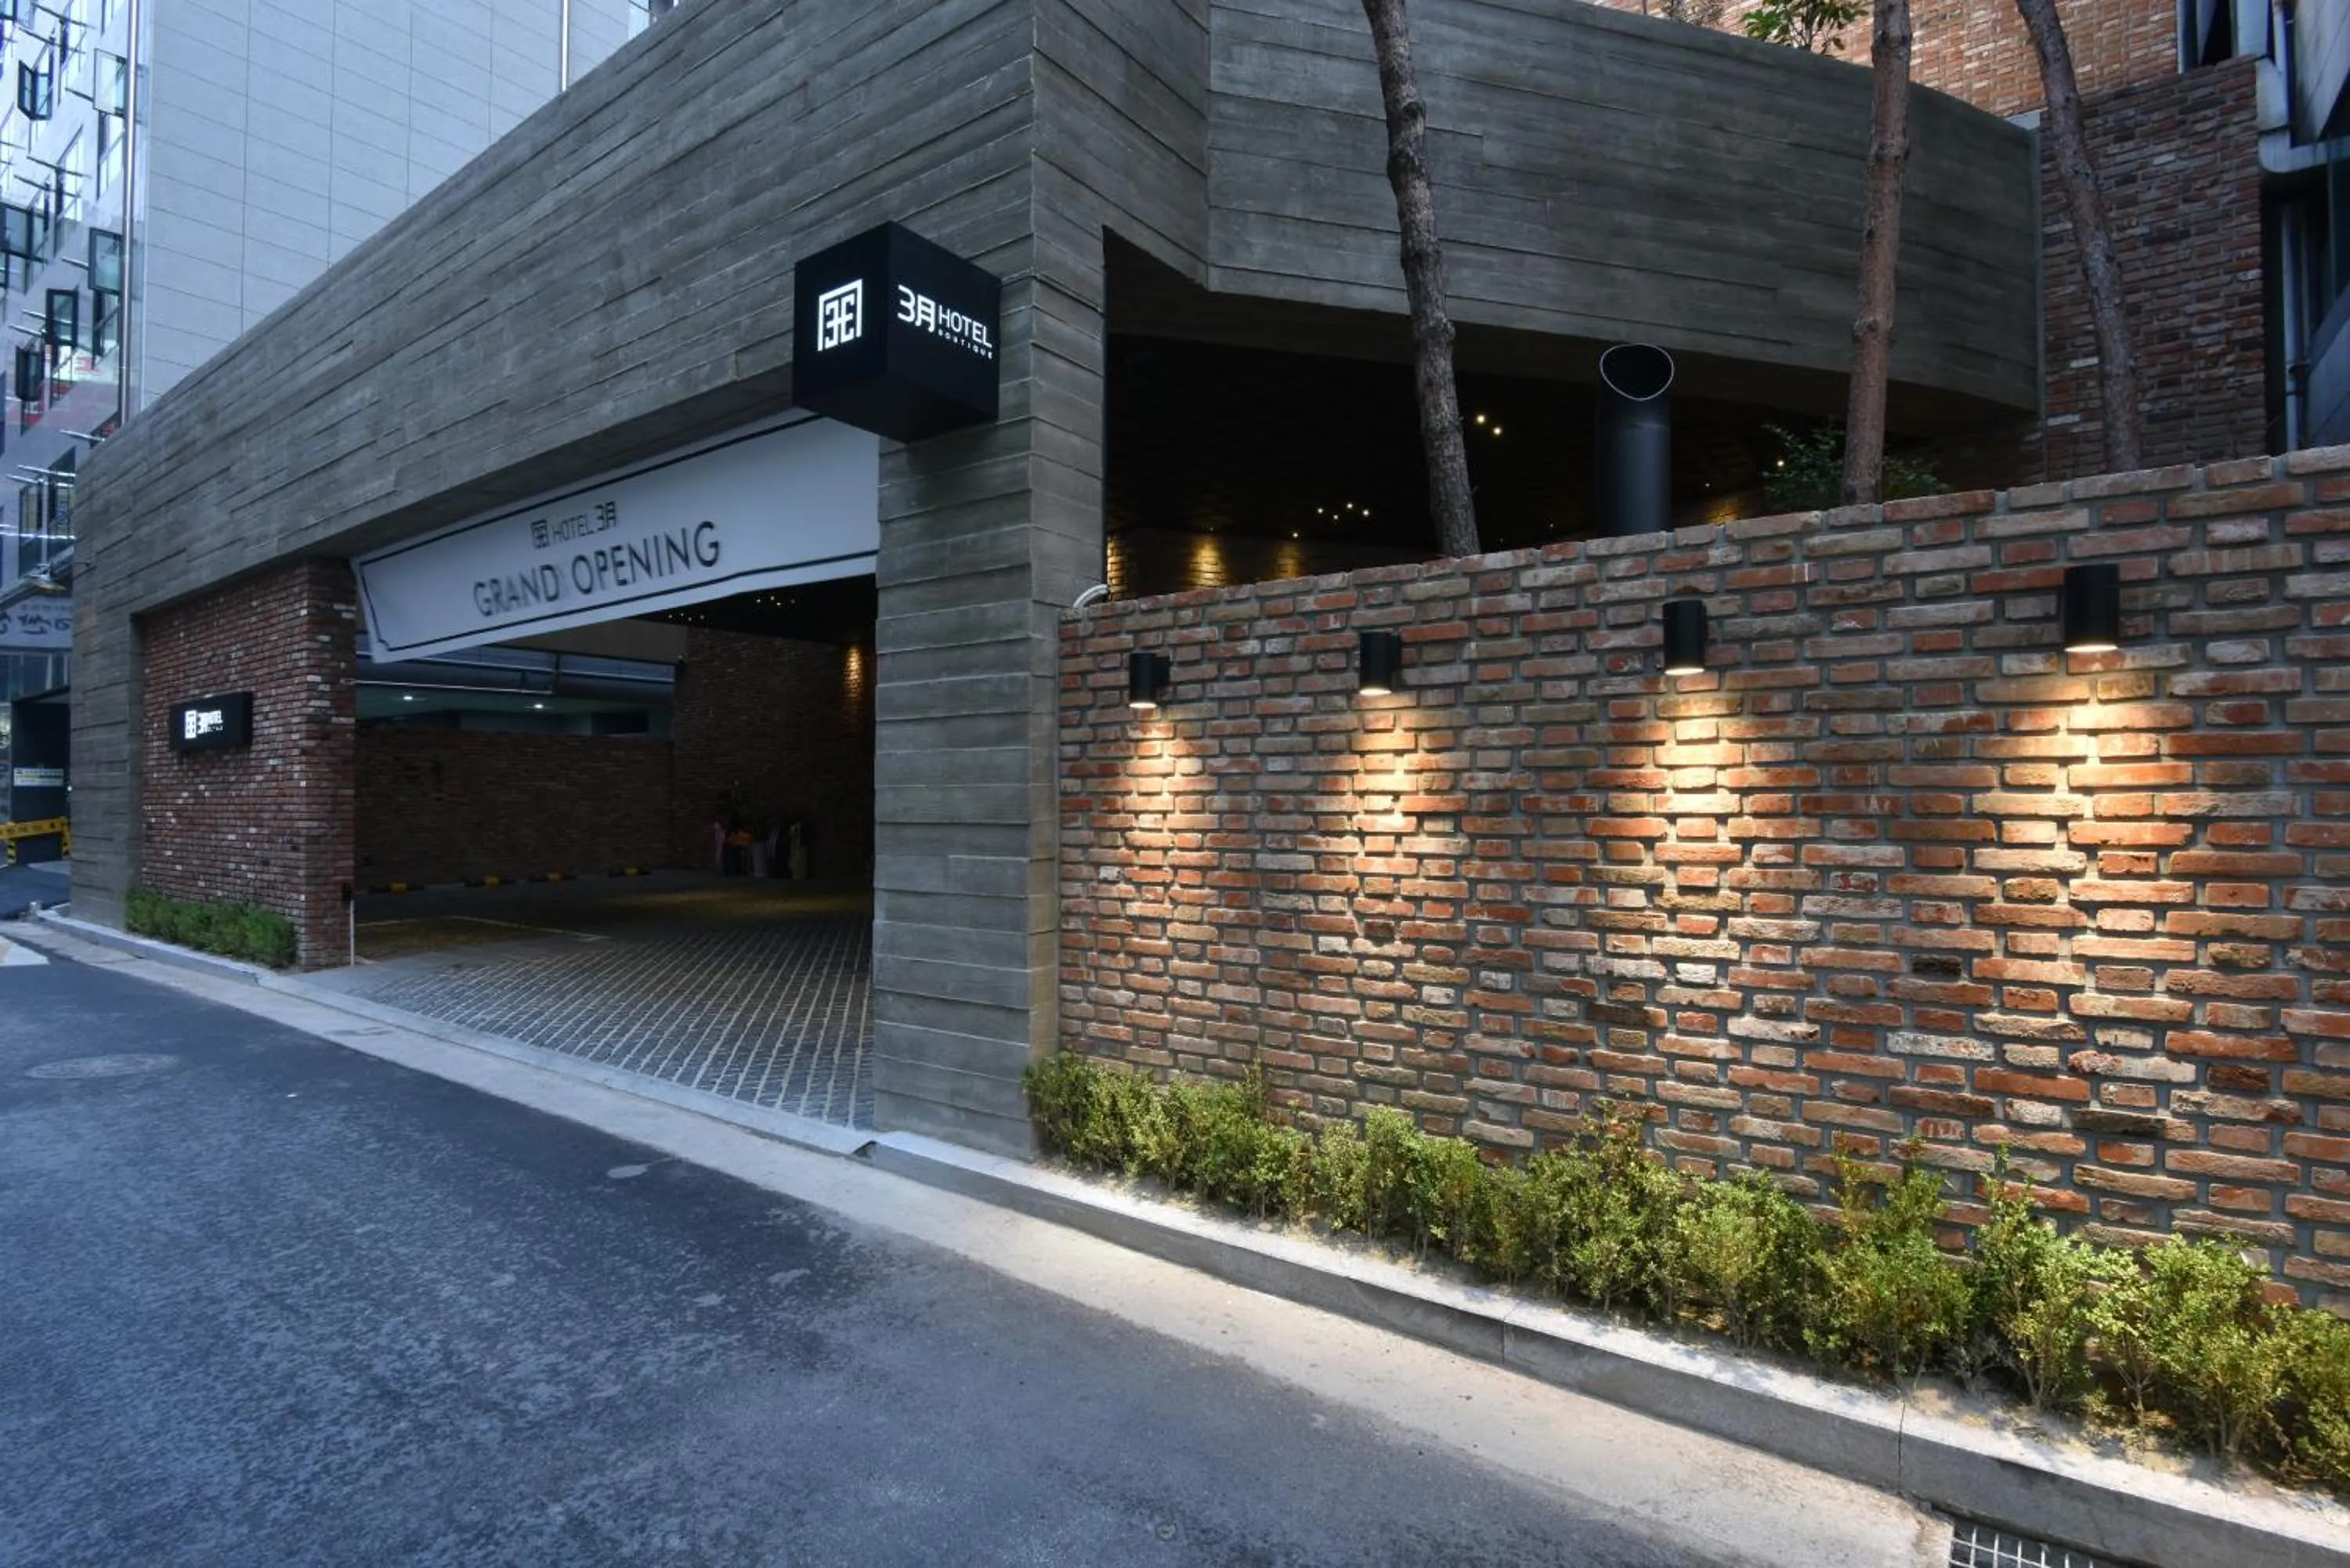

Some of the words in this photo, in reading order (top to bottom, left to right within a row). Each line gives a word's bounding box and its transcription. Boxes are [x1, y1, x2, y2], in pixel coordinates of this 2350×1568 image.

[938, 304, 992, 349] HOTEL
[938, 328, 992, 359] BOUTIQUE
[551, 514, 595, 544] HOTEL
[473, 564, 560, 617] GRAND
[571, 521, 720, 594] OPENING
